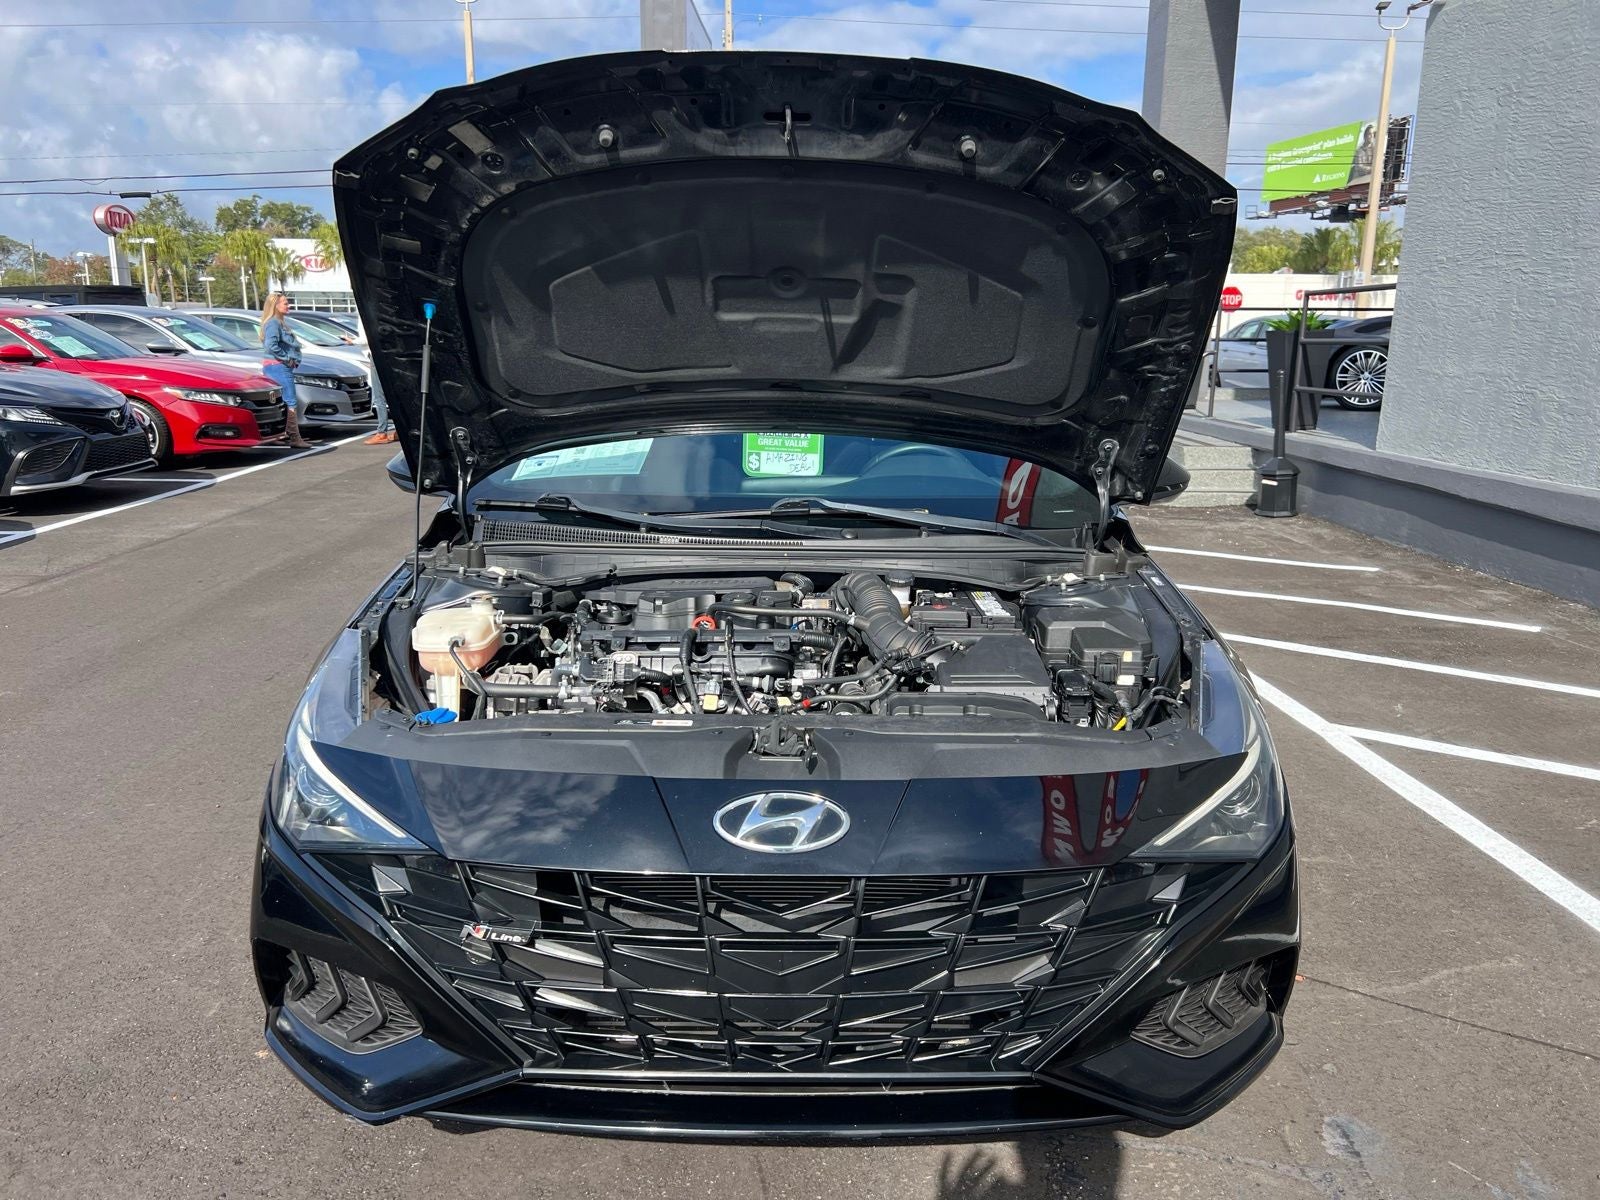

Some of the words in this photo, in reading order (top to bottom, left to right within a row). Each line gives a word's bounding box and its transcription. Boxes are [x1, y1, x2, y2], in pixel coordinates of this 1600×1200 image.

[108, 210, 131, 229] KIA
[757, 437, 783, 447] GREAT
[784, 439, 810, 448] VALUE
[491, 932, 522, 943] Line
